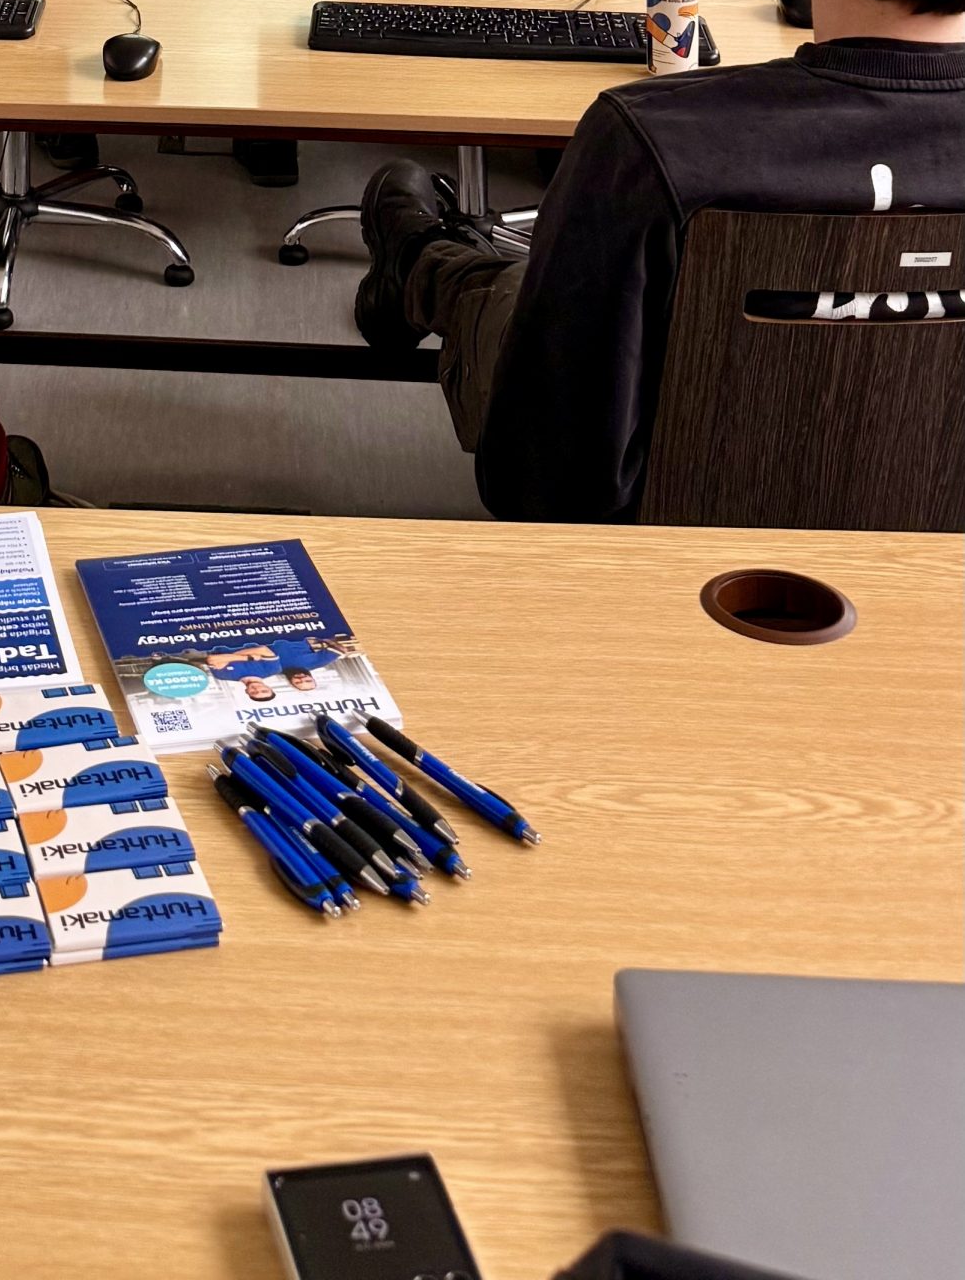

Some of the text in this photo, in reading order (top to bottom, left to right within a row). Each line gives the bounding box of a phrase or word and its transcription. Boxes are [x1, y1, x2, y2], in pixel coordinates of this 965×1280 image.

[32, 613, 47, 621] při
[214, 618, 264, 628] VÝROBNÍ
[264, 612, 319, 621] OBSLUHA
[10, 628, 51, 637] Brigáda
[137, 620, 325, 645] Hledáme nové kolegy
[22, 662, 60, 671] Hledáš
[236, 696, 381, 722] Huhtamaki
[19, 766, 154, 797] Huhtamaki
[41, 833, 182, 860] Huhtamaki
[60, 900, 208, 930] Huhtamaki
[341, 1196, 383, 1221] 08
[350, 1218, 389, 1241] 49
